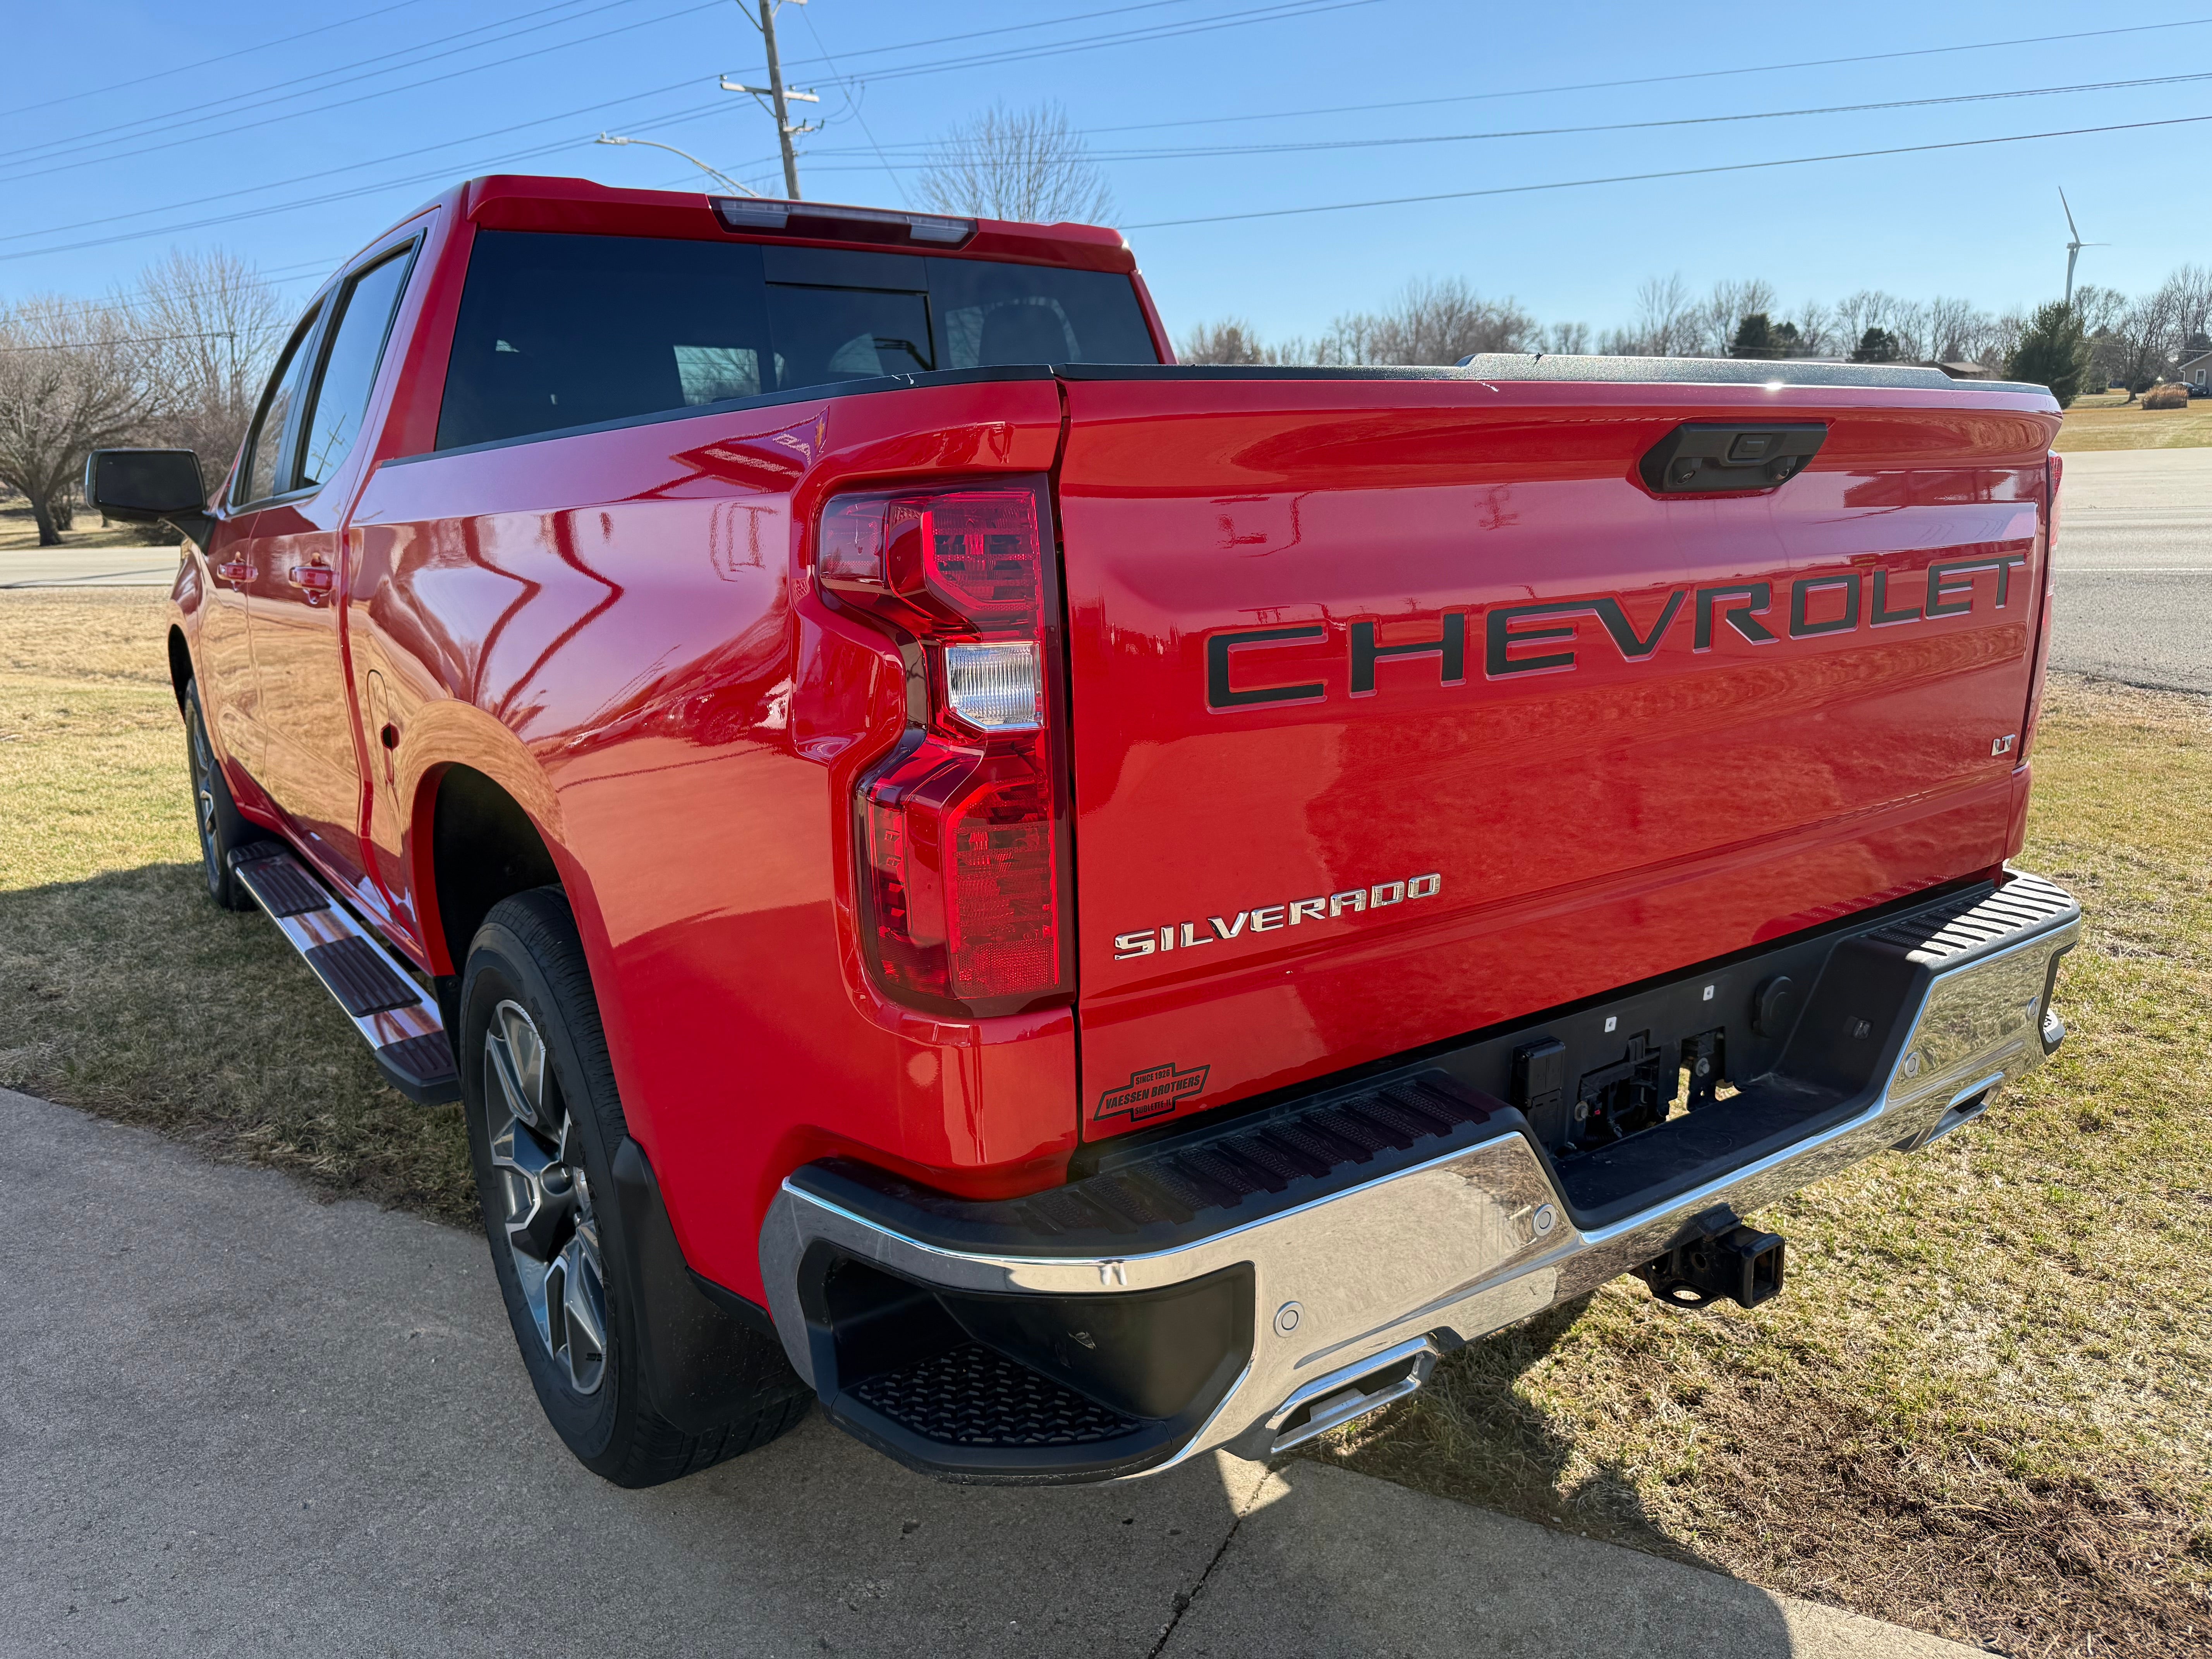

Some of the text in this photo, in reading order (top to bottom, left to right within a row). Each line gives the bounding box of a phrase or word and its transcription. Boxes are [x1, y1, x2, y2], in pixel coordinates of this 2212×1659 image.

[1207, 554, 2025, 713] CHEVROLET
[1991, 734, 2016, 756] LT
[1114, 872, 1441, 960] SILVERADO
[1106, 1075, 1200, 1109] VAESSEN BROTHERS
[1135, 1069, 1170, 1085] SINCE 1926
